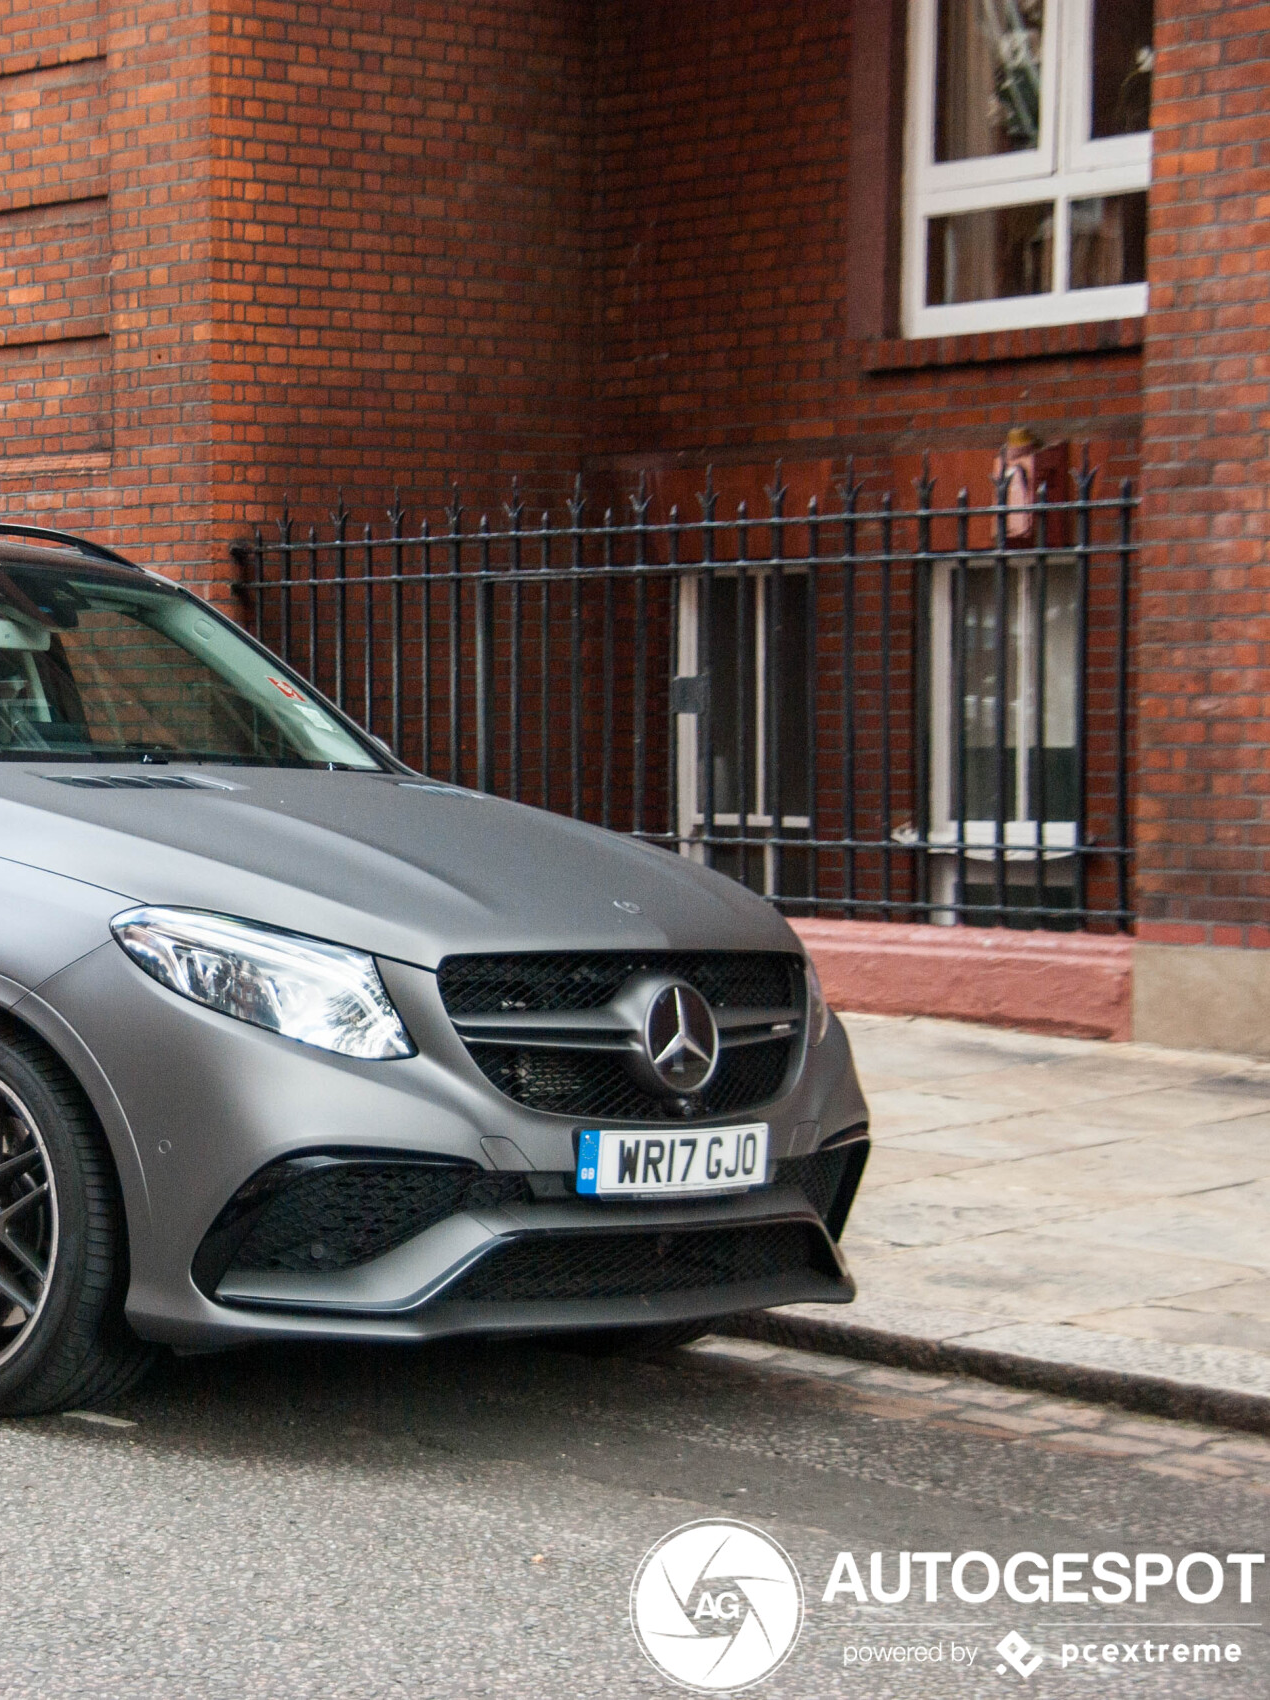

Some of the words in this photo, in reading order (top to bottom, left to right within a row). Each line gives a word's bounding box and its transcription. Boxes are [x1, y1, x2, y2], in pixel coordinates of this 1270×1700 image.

[580, 1167, 596, 1181] GB
[617, 1138, 699, 1184] WR17
[706, 1132, 758, 1180] GJO
